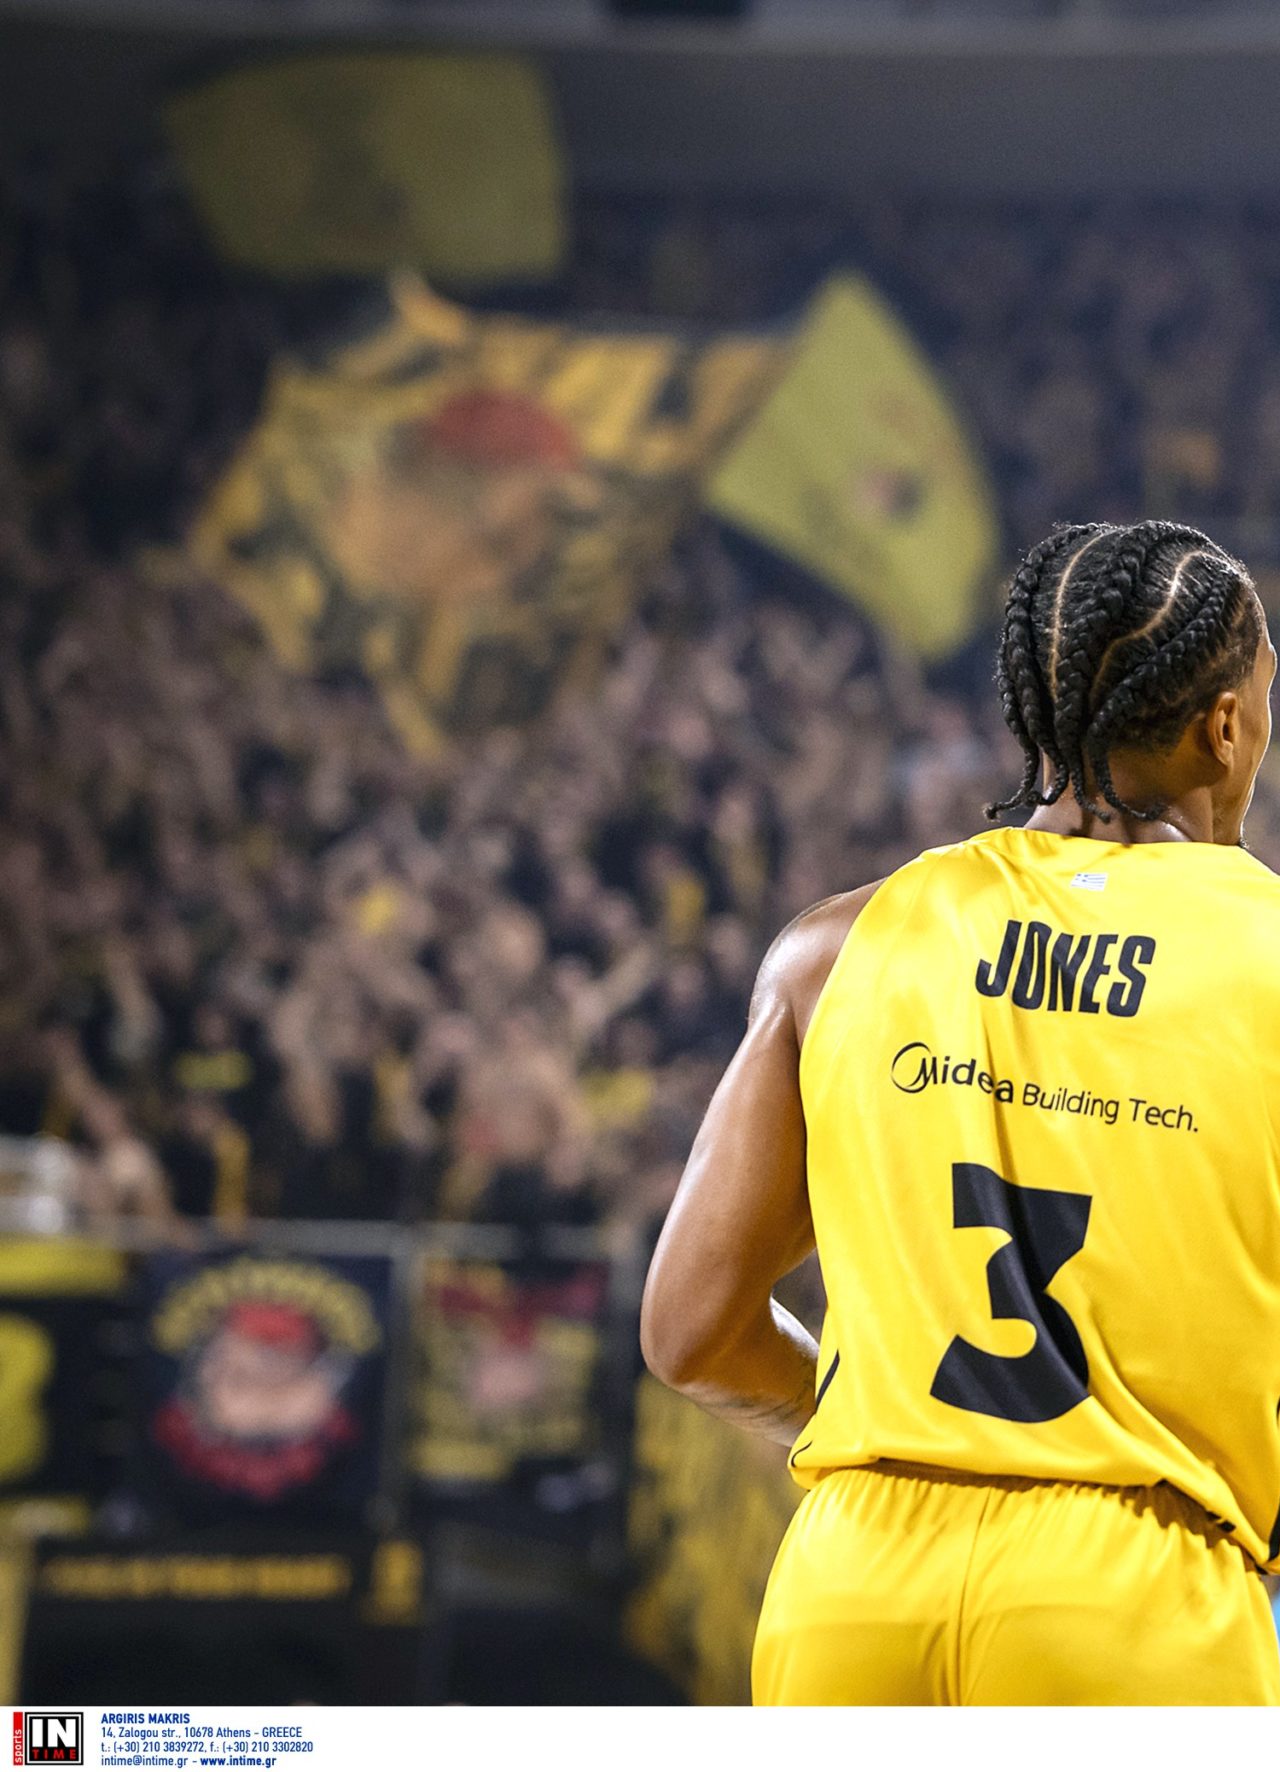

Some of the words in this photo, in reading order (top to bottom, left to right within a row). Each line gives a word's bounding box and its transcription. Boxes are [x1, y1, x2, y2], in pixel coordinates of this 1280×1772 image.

[975, 919, 1157, 1018] JONES
[891, 1041, 1014, 1104] Midea
[1022, 1083, 1120, 1125] Building
[1128, 1097, 1199, 1132] Tech.
[929, 1162, 1093, 1424] 3
